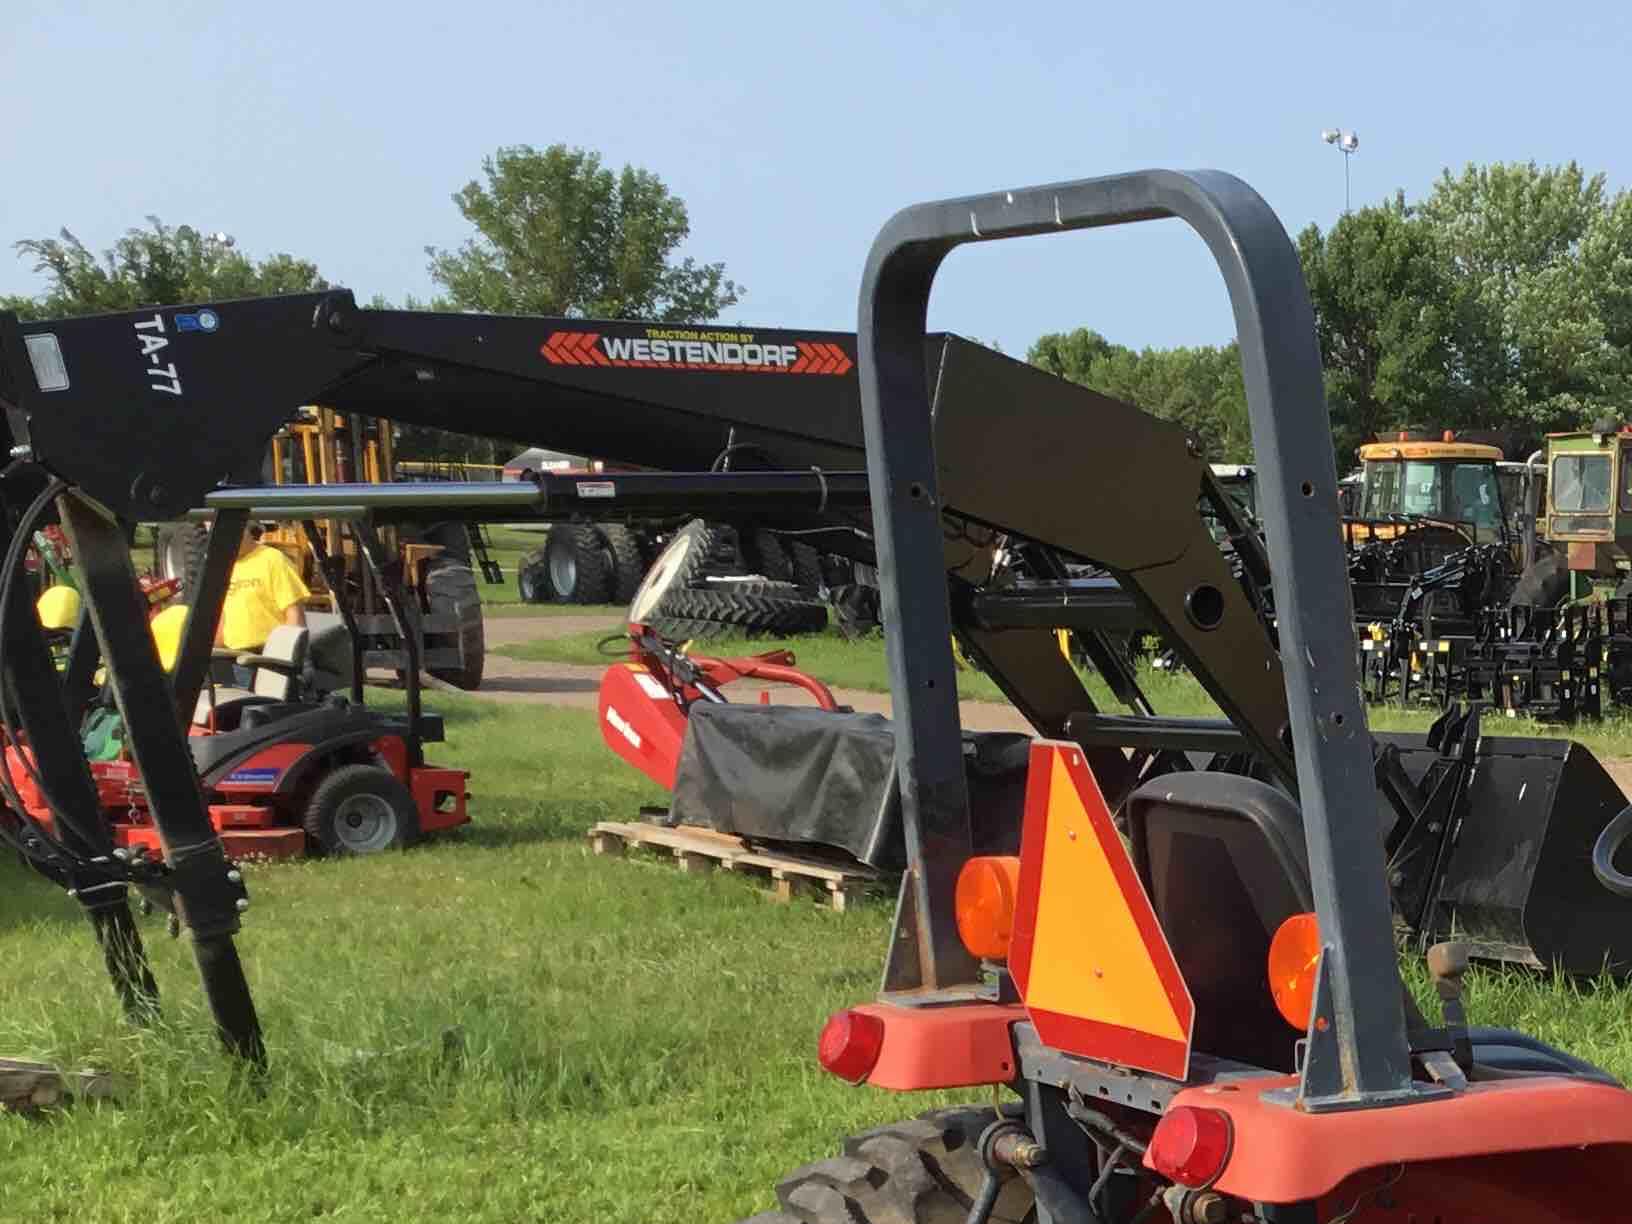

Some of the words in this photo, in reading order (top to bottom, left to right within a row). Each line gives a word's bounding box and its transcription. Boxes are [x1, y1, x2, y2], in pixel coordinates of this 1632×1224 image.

[646, 329, 698, 342] TRACTION
[700, 331, 738, 343] ACTION
[134, 314, 182, 395] TA-77
[603, 337, 796, 367] WESTENDORF
